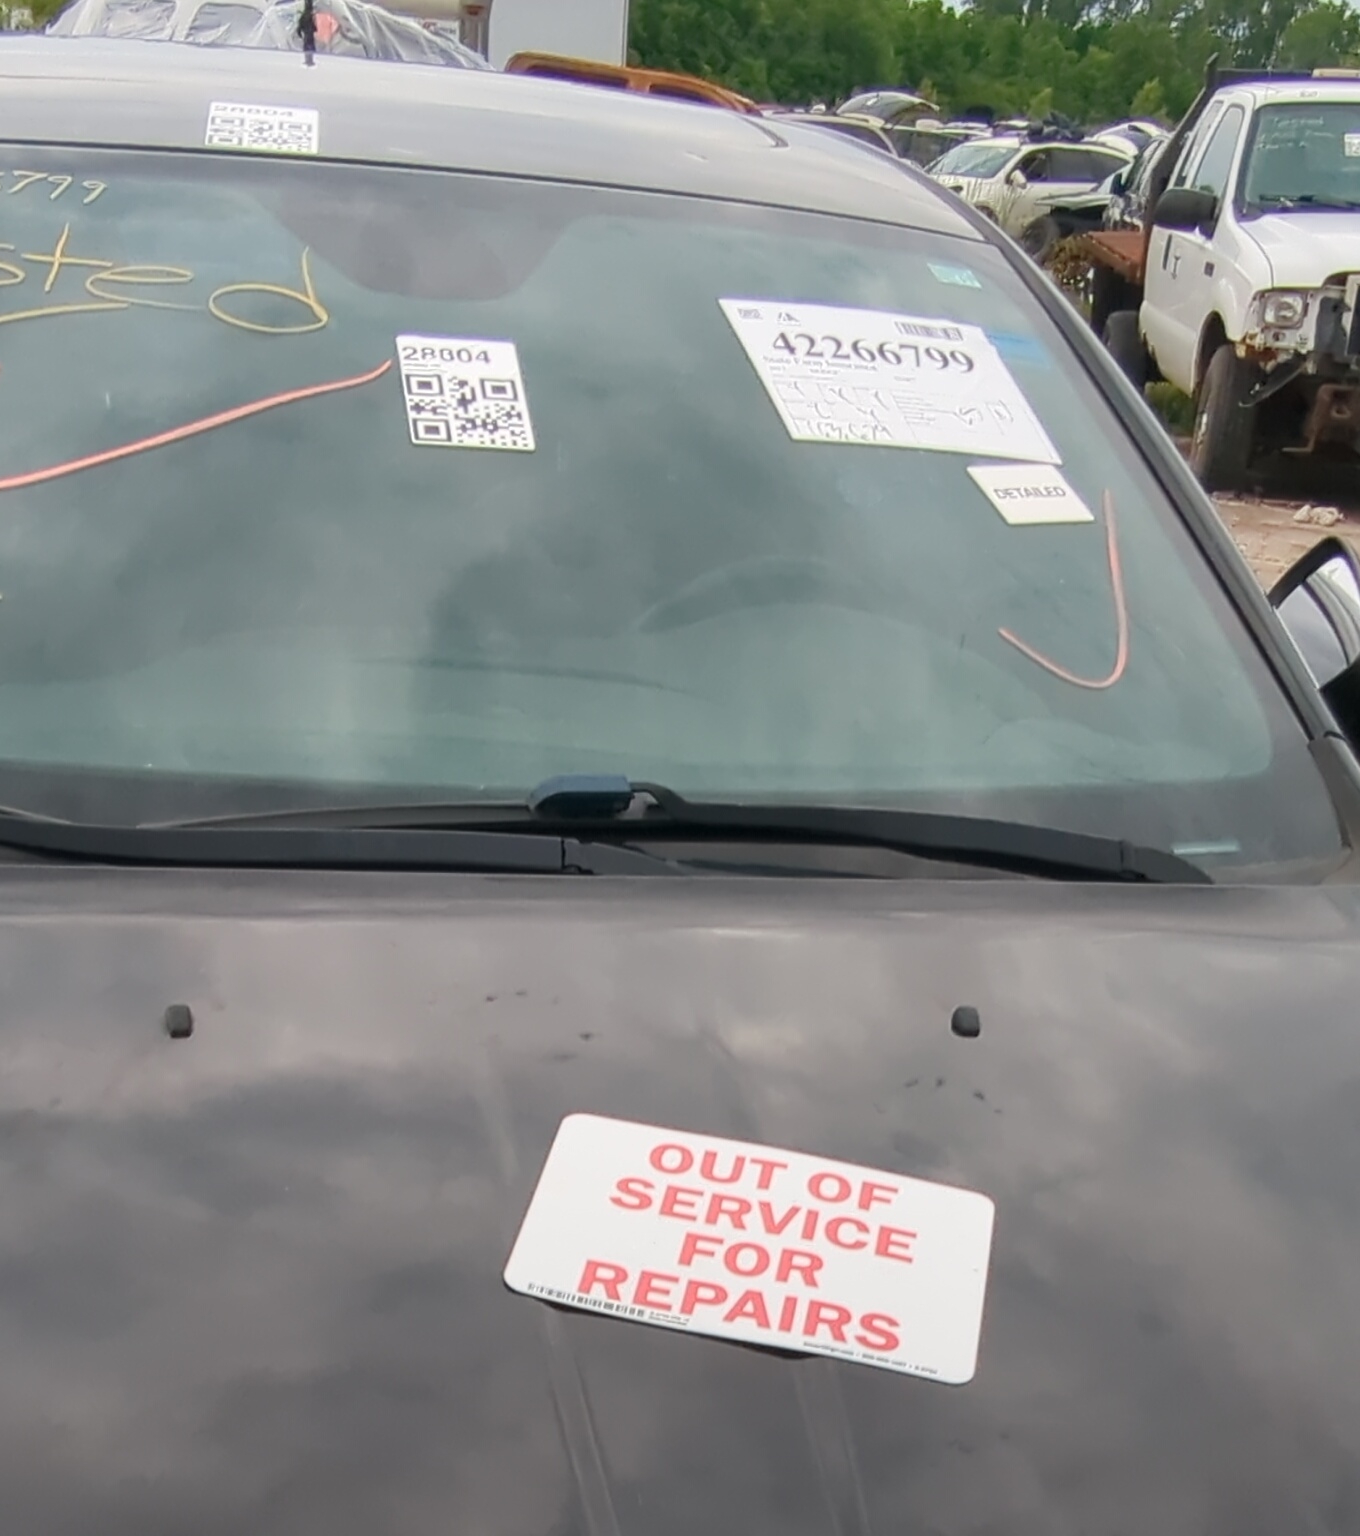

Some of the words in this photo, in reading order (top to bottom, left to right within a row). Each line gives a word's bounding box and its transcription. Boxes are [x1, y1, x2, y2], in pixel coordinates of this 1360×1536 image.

[401, 346, 491, 364] 28804
[772, 331, 975, 374] 42266799
[992, 484, 1067, 501] DETAILED
[648, 1143, 789, 1191] OUT
[806, 1171, 900, 1211] OF
[608, 1177, 918, 1264] SERVICE
[677, 1232, 825, 1289] FOR
[576, 1259, 902, 1352] REPAIRS
